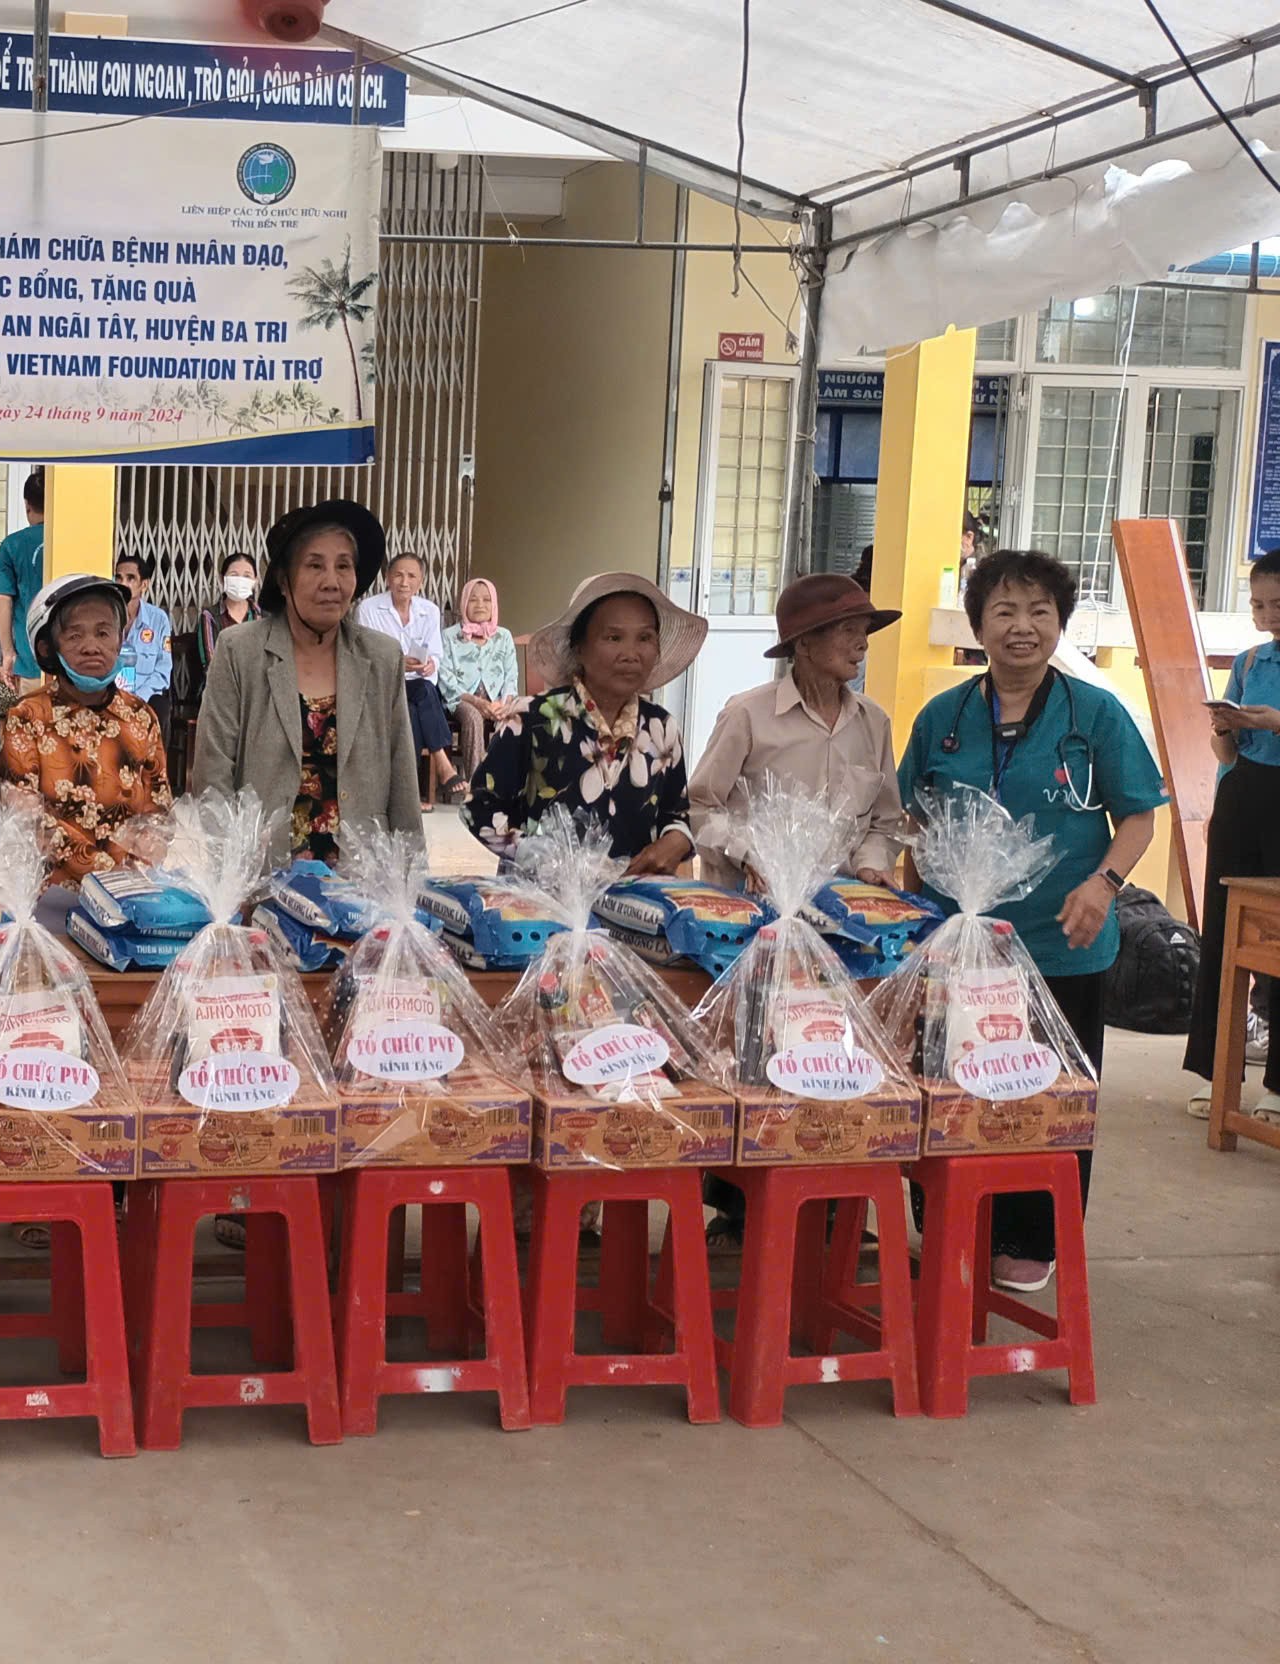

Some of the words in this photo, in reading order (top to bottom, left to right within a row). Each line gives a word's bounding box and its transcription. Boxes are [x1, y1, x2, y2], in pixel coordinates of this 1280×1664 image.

[17, 57, 33, 91] TR
[50, 51, 97, 95] THÀNH
[102, 62, 130, 97] CON
[194, 59, 221, 101] TRÒ
[227, 56, 259, 110] GIỎI,
[264, 62, 301, 105] CÔNG
[305, 65, 332, 106] DÂN
[182, 205, 204, 214] LIÊN
[208, 205, 231, 216] HIỆP
[234, 206, 253, 216] CÁC
[256, 205, 268, 217] TỔ
[271, 207, 298, 217] CHỨC
[301, 208, 320, 217] HỮU
[323, 209, 347, 219] NGHỊ
[231, 218, 254, 228] TỈNH
[49, 235, 104, 261] CHỮA
[112, 236, 168, 267] BỆNH
[176, 239, 235, 265] NHÂN
[243, 243, 288, 270] ĐẠO,
[19, 268, 84, 302] BỔNG,
[92, 275, 146, 305] TẶNG
[154, 276, 196, 303] QUÀ
[2, 314, 31, 336] AN
[39, 313, 89, 339] NGÃI
[97, 313, 137, 342] TÂY,
[145, 315, 215, 345] HUYỆN
[222, 321, 248, 342] BA
[255, 321, 287, 343] TRI
[7, 353, 101, 376] VIETNAM
[109, 356, 235, 380] FOUNDATION
[243, 355, 274, 381] TÀI
[282, 357, 322, 384] TRỢ
[852, 389, 882, 400] SẠC
[25, 406, 42, 419] 24
[48, 406, 90, 423] tháng
[97, 408, 104, 420] 9
[110, 407, 141, 421] năm
[148, 409, 183, 422] 2024
[382, 1032, 424, 1055] CHỨC
[429, 1036, 455, 1053] PVF
[594, 1035, 633, 1061] CHỨC
[379, 1061, 409, 1073] KÍNH
[413, 1060, 443, 1073] TẶNG
[600, 1062, 631, 1076] KÍNH
[803, 1052, 842, 1074] CHỨC
[958, 1054, 979, 1080] TỔ
[983, 1050, 1020, 1077] CHỨC
[1024, 1050, 1050, 1071] PVF
[61, 1067, 92, 1086] PVF
[187, 1060, 207, 1088] TỔ
[214, 1063, 256, 1086] CHỨC
[261, 1065, 291, 1083] PVF
[6, 1086, 36, 1098] KÍNH
[832, 1080, 859, 1091] TẶNG
[1016, 1077, 1042, 1091] TẶNG
[245, 1089, 276, 1102] TẶNG
